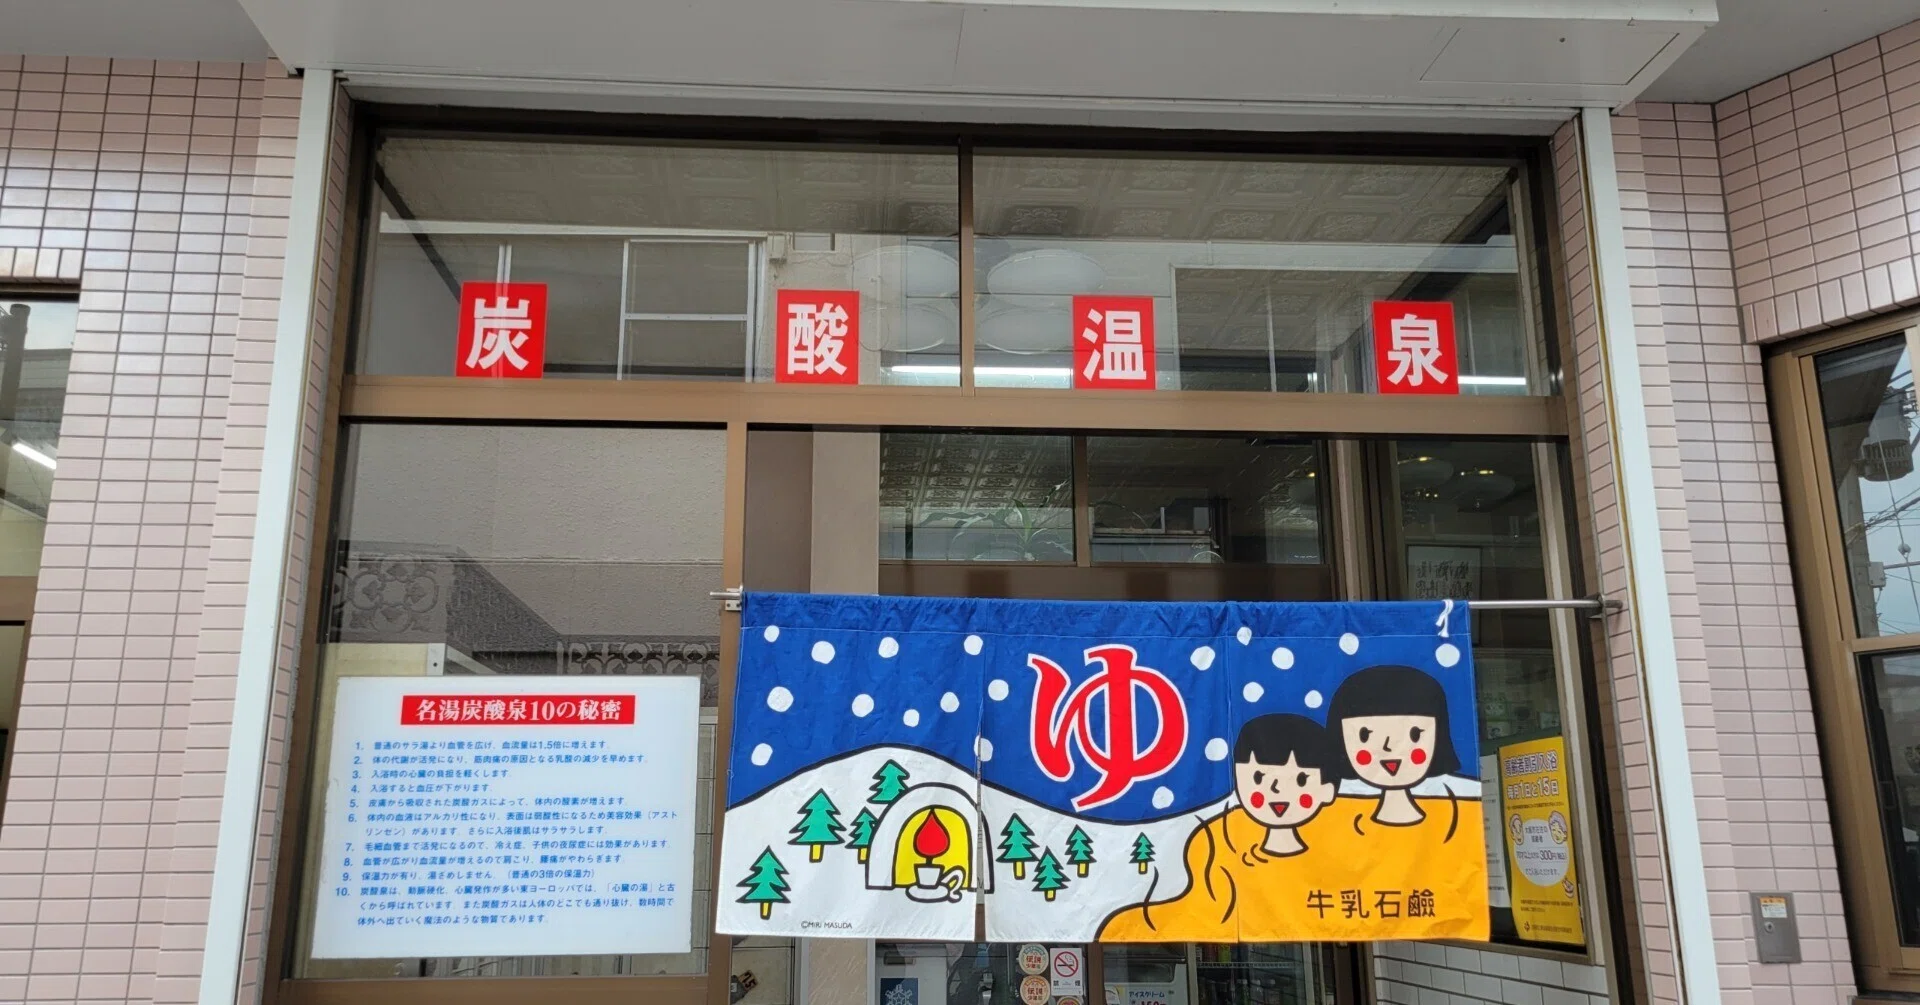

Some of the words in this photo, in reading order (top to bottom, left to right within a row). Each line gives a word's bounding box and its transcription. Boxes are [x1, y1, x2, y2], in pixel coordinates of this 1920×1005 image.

[466, 296, 531, 370] 炭
[787, 302, 849, 375] 酸
[1082, 308, 1147, 381] 温
[1387, 314, 1448, 386] 泉
[416, 699, 622, 721] 名湯炭酸泉10の秘密
[1027, 644, 1189, 812] ゆ
[824, 921, 853, 929] MASUDA
